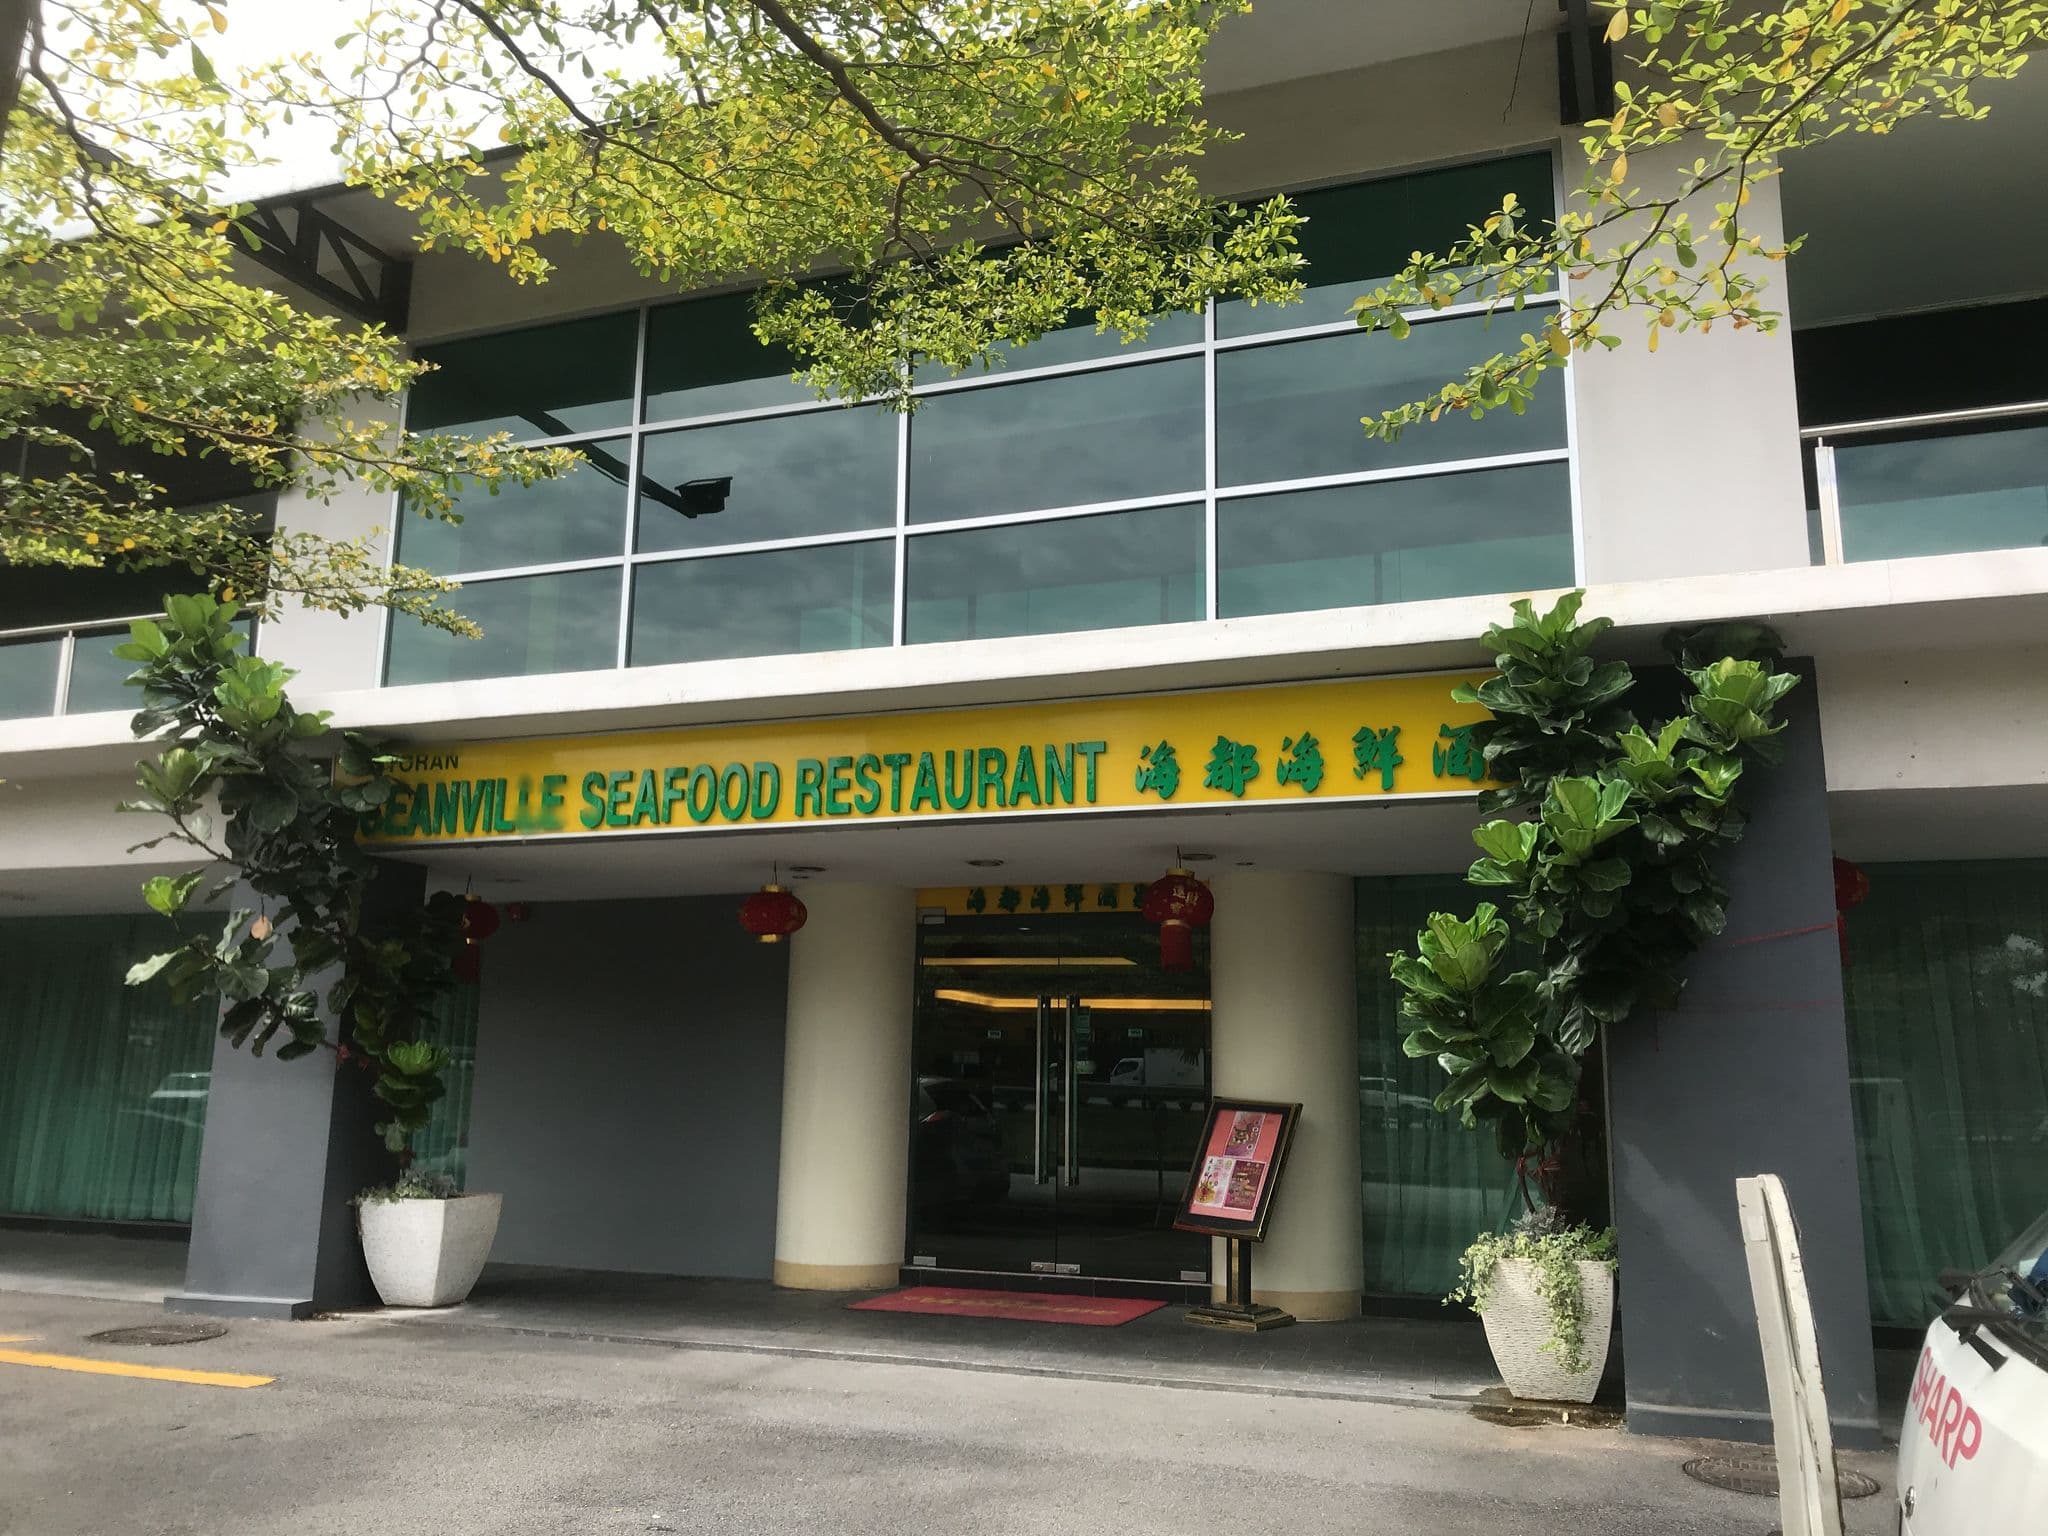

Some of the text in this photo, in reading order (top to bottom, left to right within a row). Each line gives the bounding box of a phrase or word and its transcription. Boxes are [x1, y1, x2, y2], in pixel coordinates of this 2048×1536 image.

[580, 760, 782, 829] SEAFOOD
[794, 740, 1108, 818] RESTAURANT
[1911, 1345, 1983, 1471] SHARP
